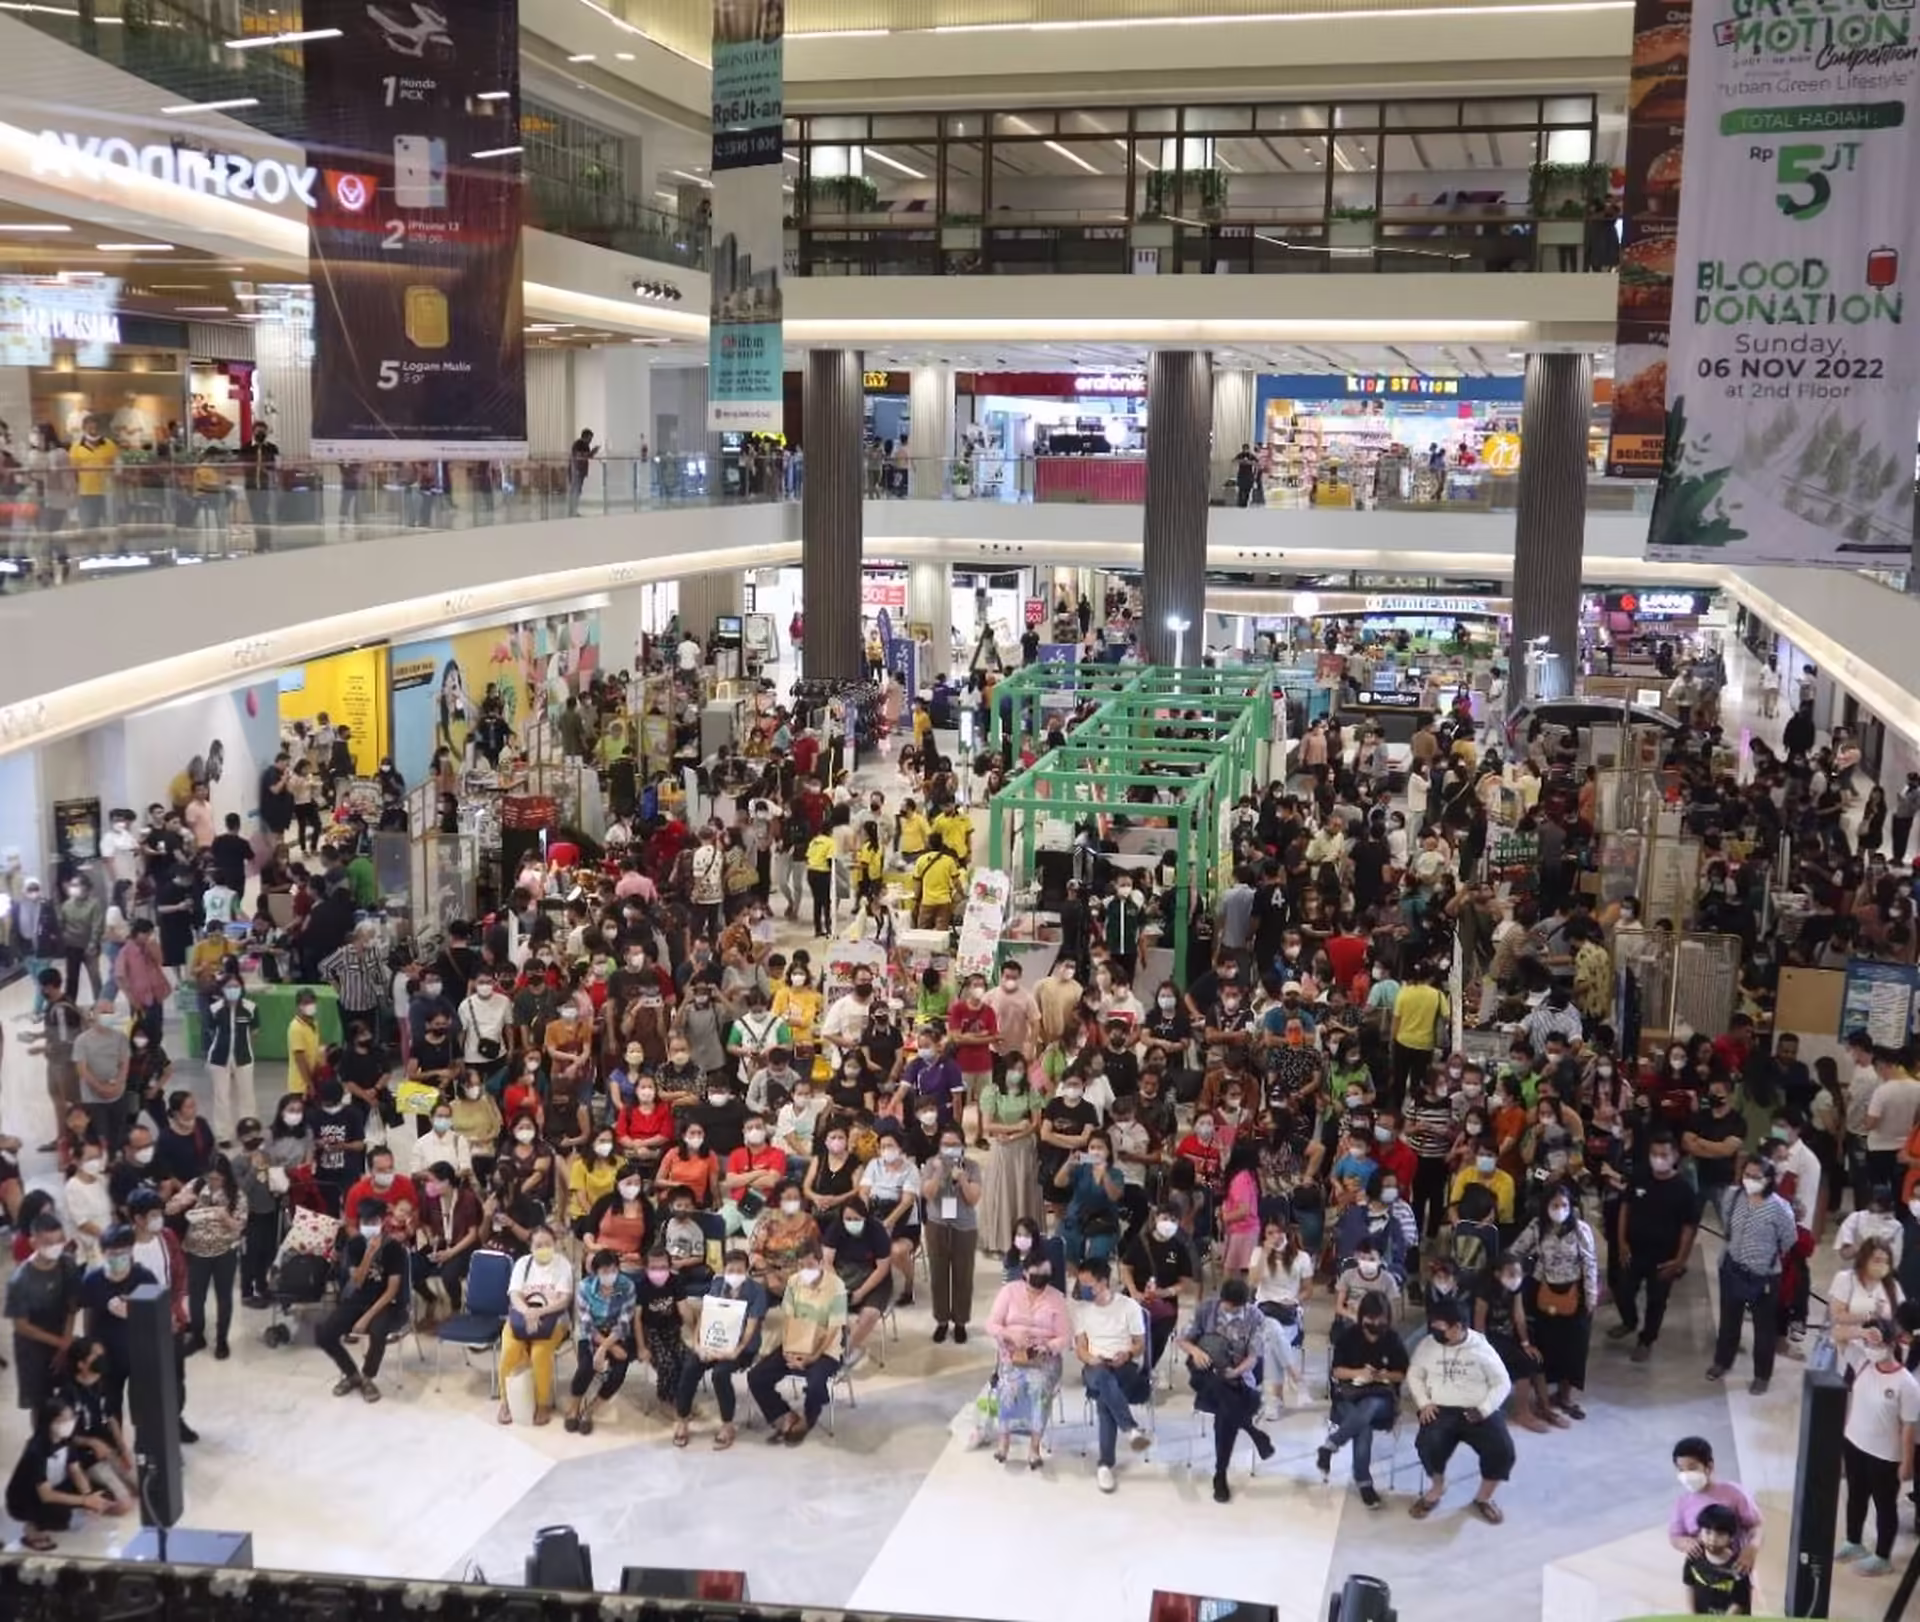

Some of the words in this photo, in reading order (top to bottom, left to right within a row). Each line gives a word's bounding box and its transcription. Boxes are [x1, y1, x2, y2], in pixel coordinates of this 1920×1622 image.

[1735, 12, 1911, 54] MOTION
[1815, 44, 1919, 71] Competition
[382, 76, 397, 107] 1
[1776, 78, 1831, 93] Green
[1741, 114, 1793, 128] TOTAL
[1799, 110, 1869, 126] HADIAH
[1749, 146, 1774, 162] Rp
[1776, 144, 1831, 220] 5
[1821, 142, 1863, 171] JT
[381, 218, 405, 249] 2
[1698, 258, 1829, 291] BLOOD
[1695, 292, 1904, 325] DONATION
[1735, 333, 1847, 357] Sunday,
[377, 360, 400, 389] 5
[402, 361, 440, 373] Logam
[1698, 358, 1730, 379] 06
[1741, 358, 1806, 378] NOV
[1815, 358, 1884, 379] 2022
[1725, 383, 1743, 398] at
[1752, 382, 1790, 398] 2nd
[1798, 382, 1852, 398] Floor
